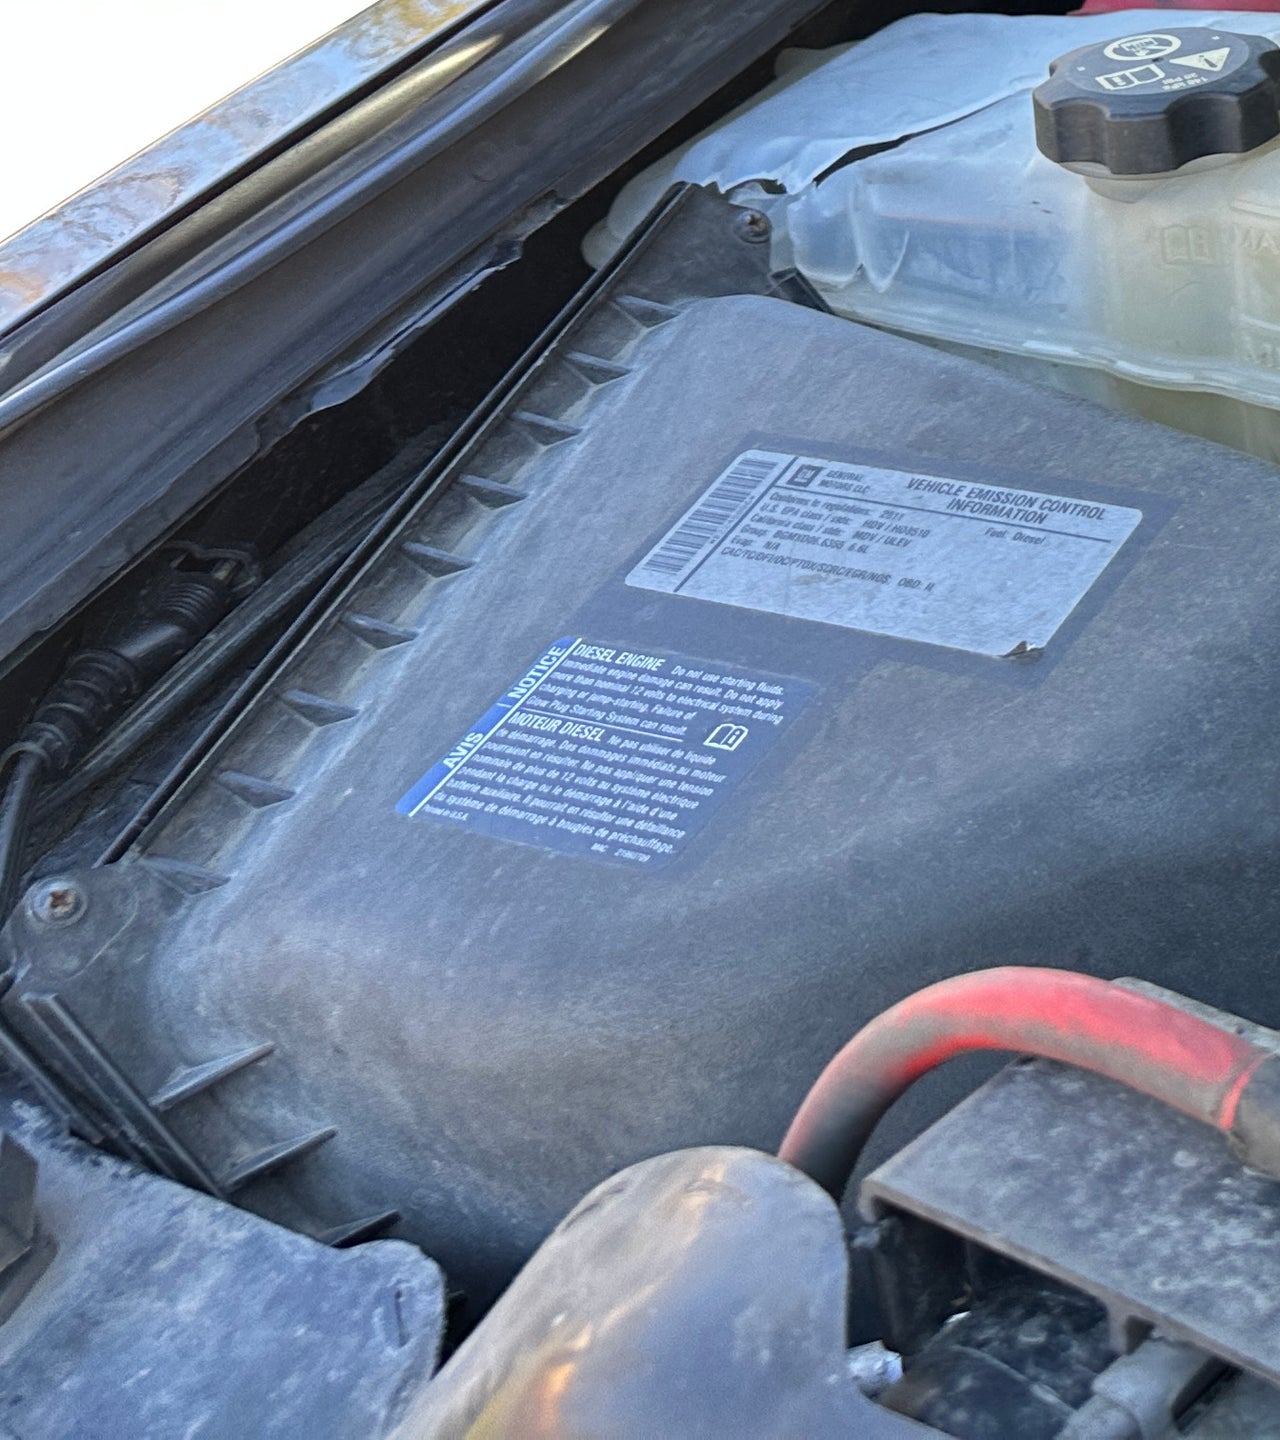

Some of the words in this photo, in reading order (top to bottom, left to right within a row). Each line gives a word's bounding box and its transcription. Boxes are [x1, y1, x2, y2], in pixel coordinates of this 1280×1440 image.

[903, 477, 967, 497] VEHICLE
[963, 487, 1039, 508] EMISSION
[1036, 498, 1110, 520] CONTROL
[944, 498, 1050, 524] INFORMATION
[1010, 531, 1047, 545] Diesel
[507, 644, 568, 700] NOTICE
[559, 658, 610, 674] Immediate
[603, 667, 639, 682] engine
[634, 672, 677, 689] damage
[672, 680, 695, 691] can
[721, 689, 741, 700] Do
[736, 692, 758, 703] not
[752, 695, 786, 710] apply
[570, 643, 620, 662] DIESEL
[613, 651, 667, 671] ENGINE
[669, 665, 689, 676] Do
[684, 668, 704, 679] not
[700, 672, 722, 682] use
[716, 675, 758, 691] starting
[524, 695, 552, 707] Glow
[545, 699, 573, 713] Plug
[566, 703, 609, 720] Starting
[602, 710, 643, 727] System
[637, 719, 660, 729] can
[535, 682, 580, 698] charging
[648, 703, 687, 718] Failure
[548, 670, 575, 682] more
[571, 673, 597, 686] than
[592, 677, 633, 693] nominal
[628, 685, 646, 695] 12
[640, 687, 669, 700] volts
[674, 694, 721, 710] electrical
[715, 703, 754, 718] system
[748, 709, 786, 725] during
[442, 730, 483, 769] AVIS
[505, 710, 564, 732] MOTEUR
[556, 721, 610, 742] DIESEL
[618, 739, 641, 751] pas
[668, 748, 687, 759] de
[480, 740, 531, 758] pourraient
[592, 764, 615, 775] pas
[610, 767, 661, 785] appliquer
[655, 777, 679, 788] une
[675, 780, 716, 796] tension
[509, 761, 528, 771] de
[522, 763, 549, 777] plus
[544, 768, 562, 779] de
[558, 771, 577, 782] 12
[571, 774, 600, 787] volts
[556, 739, 581, 752] Des
[574, 744, 630, 764] dommages
[688, 768, 728, 783] moteur
[482, 801, 501, 812] de
[552, 818, 598, 836] bougies
[592, 826, 611, 837] de
[613, 815, 637, 827] une
